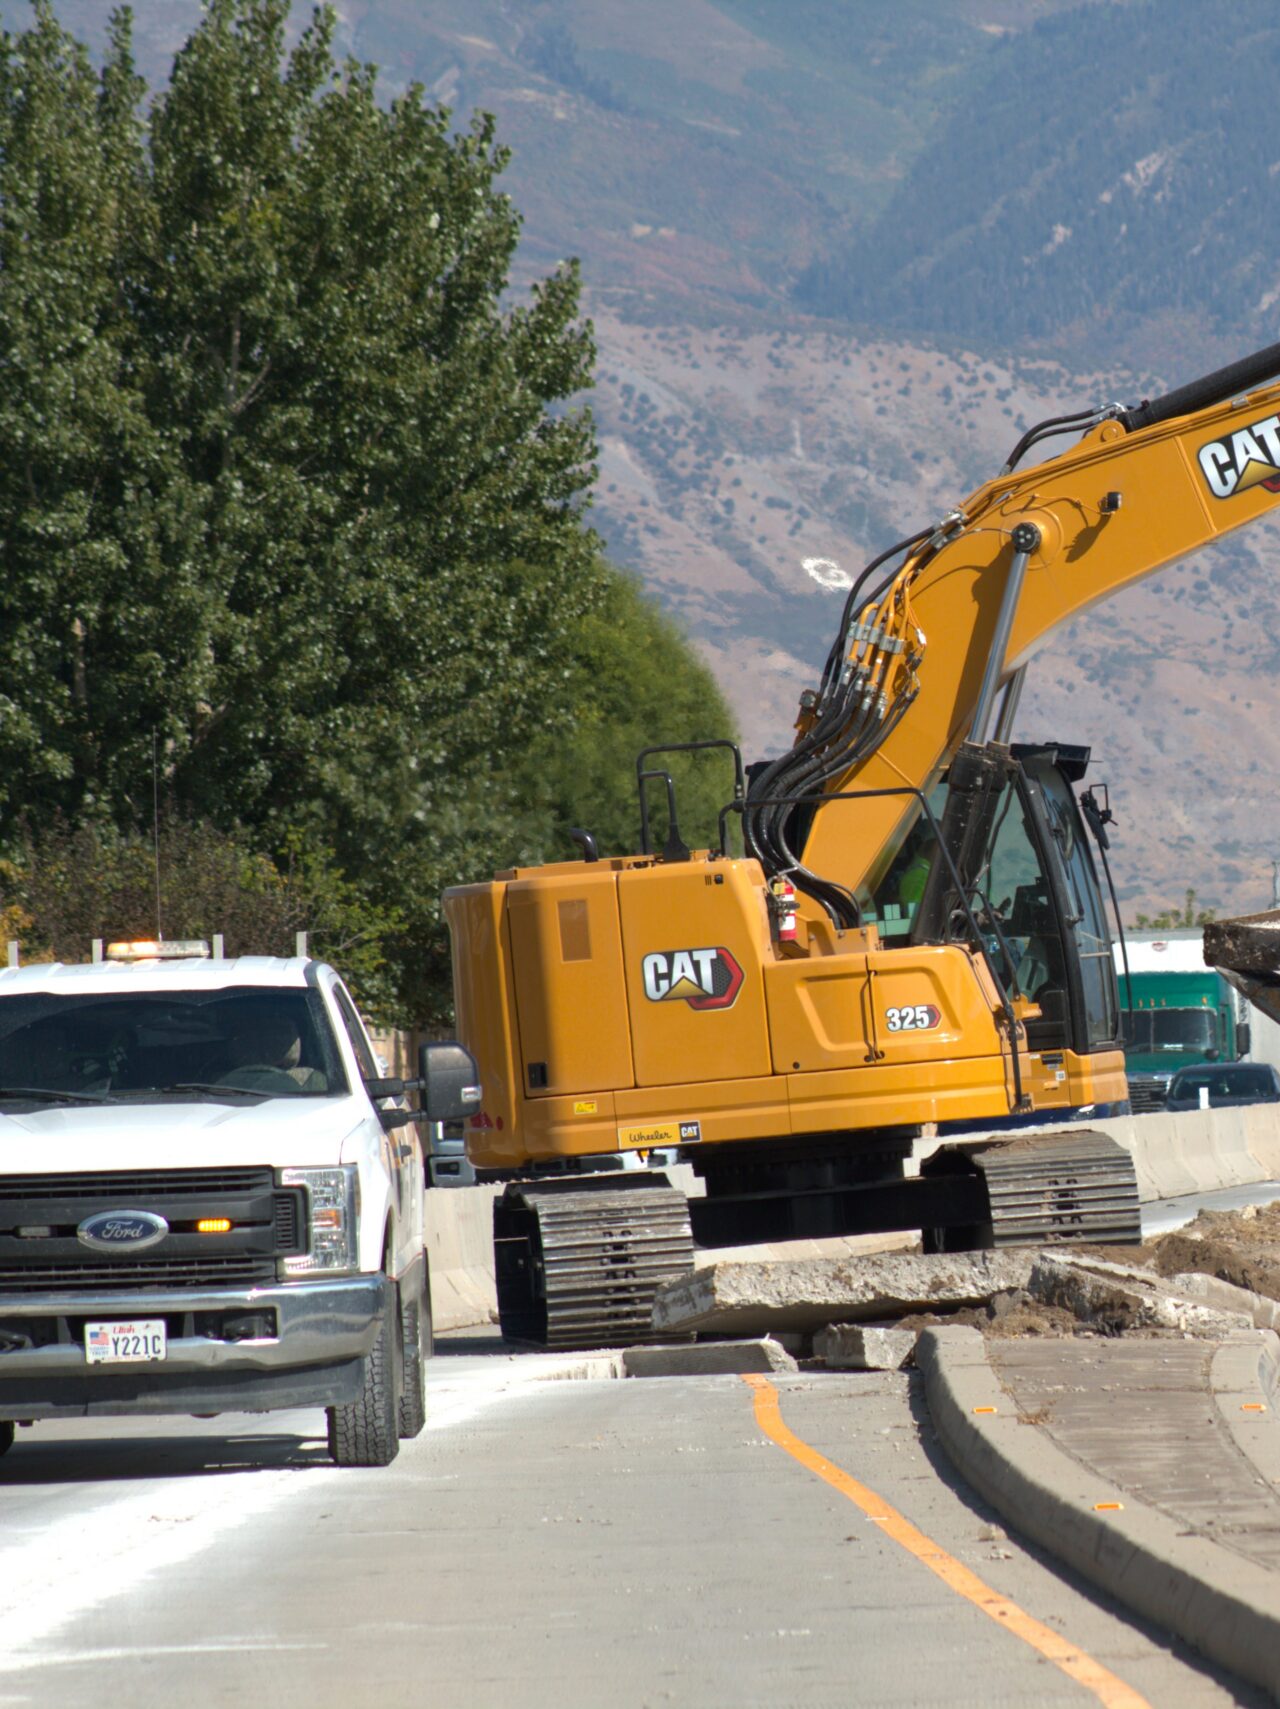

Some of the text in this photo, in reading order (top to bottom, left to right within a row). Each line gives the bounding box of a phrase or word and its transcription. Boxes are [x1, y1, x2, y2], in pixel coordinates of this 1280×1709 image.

[643, 948, 717, 1001] CAT
[886, 1005, 929, 1031] 325
[629, 1125, 698, 1143] Wheeler CAT
[102, 1220, 144, 1239] Ford
[112, 1335, 161, 1356] Y221C
